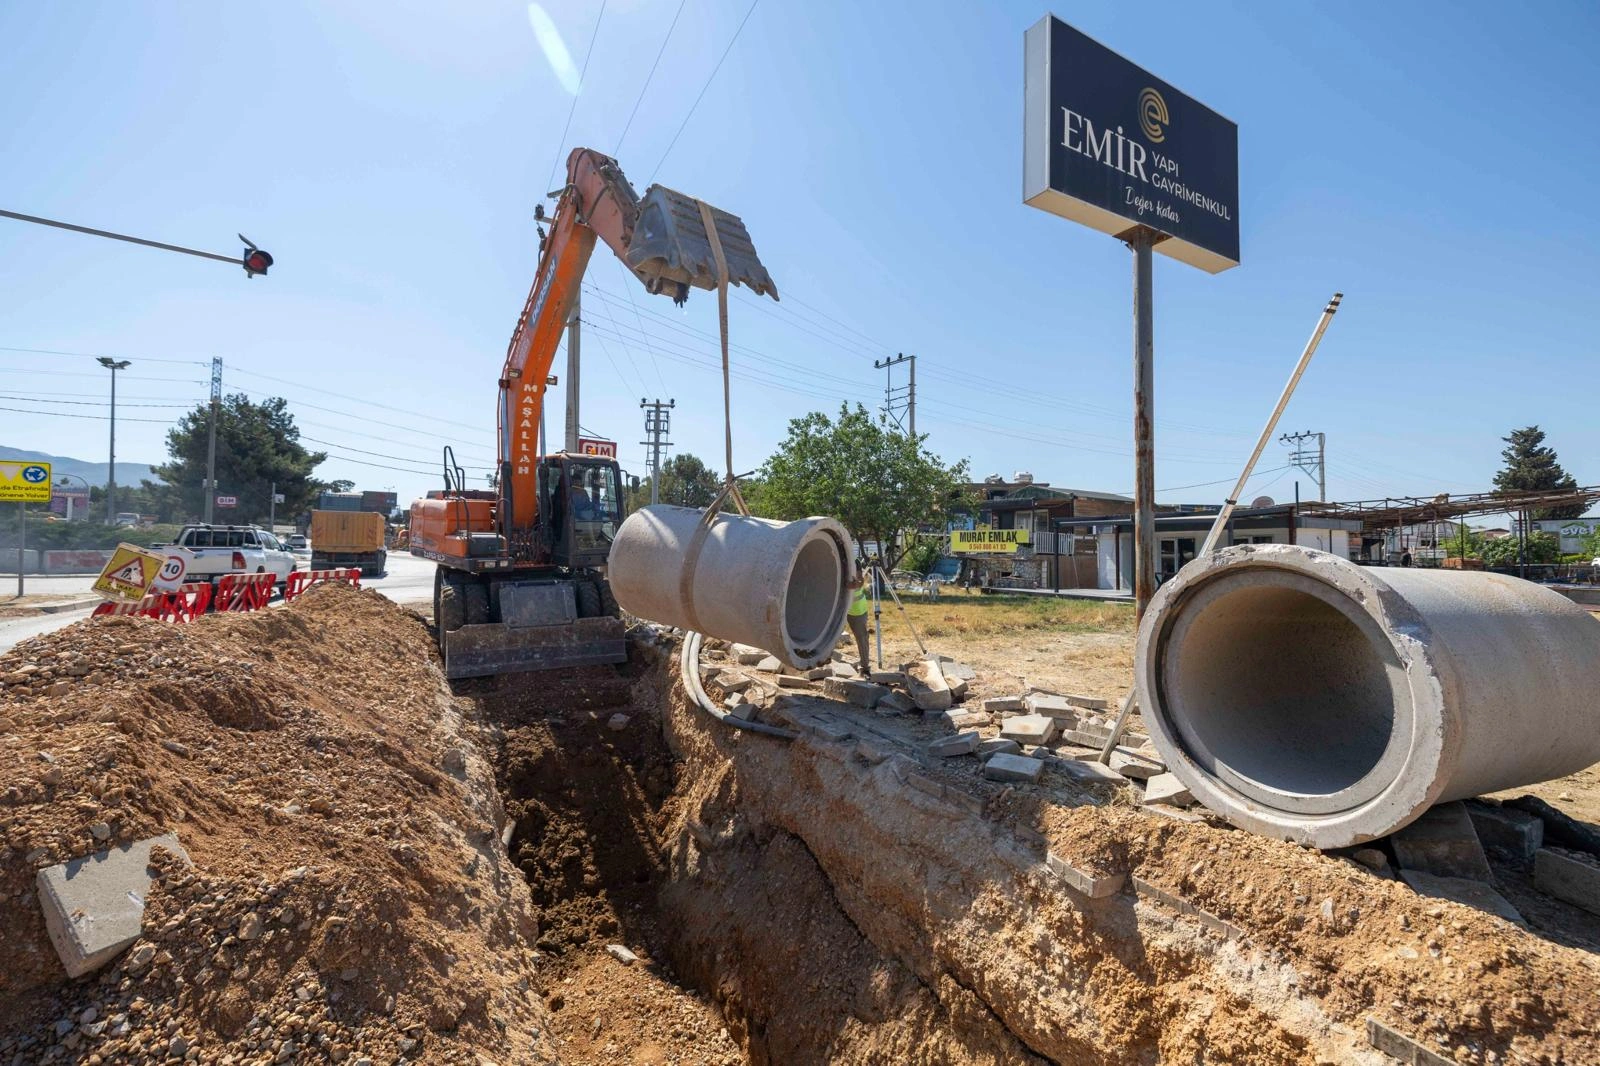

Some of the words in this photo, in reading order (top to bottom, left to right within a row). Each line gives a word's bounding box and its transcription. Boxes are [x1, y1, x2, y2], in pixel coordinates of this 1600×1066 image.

[1061, 106, 1149, 183] EMİR
[1152, 151, 1179, 177] YAPI
[1125, 186, 1153, 216] Değer
[1152, 173, 1231, 221] GAYRİMENKUL
[518, 384, 538, 475] MAŞALLAH
[960, 532, 986, 543] MURAT
[988, 531, 1017, 543] EMLAK
[164, 563, 180, 575] 10
